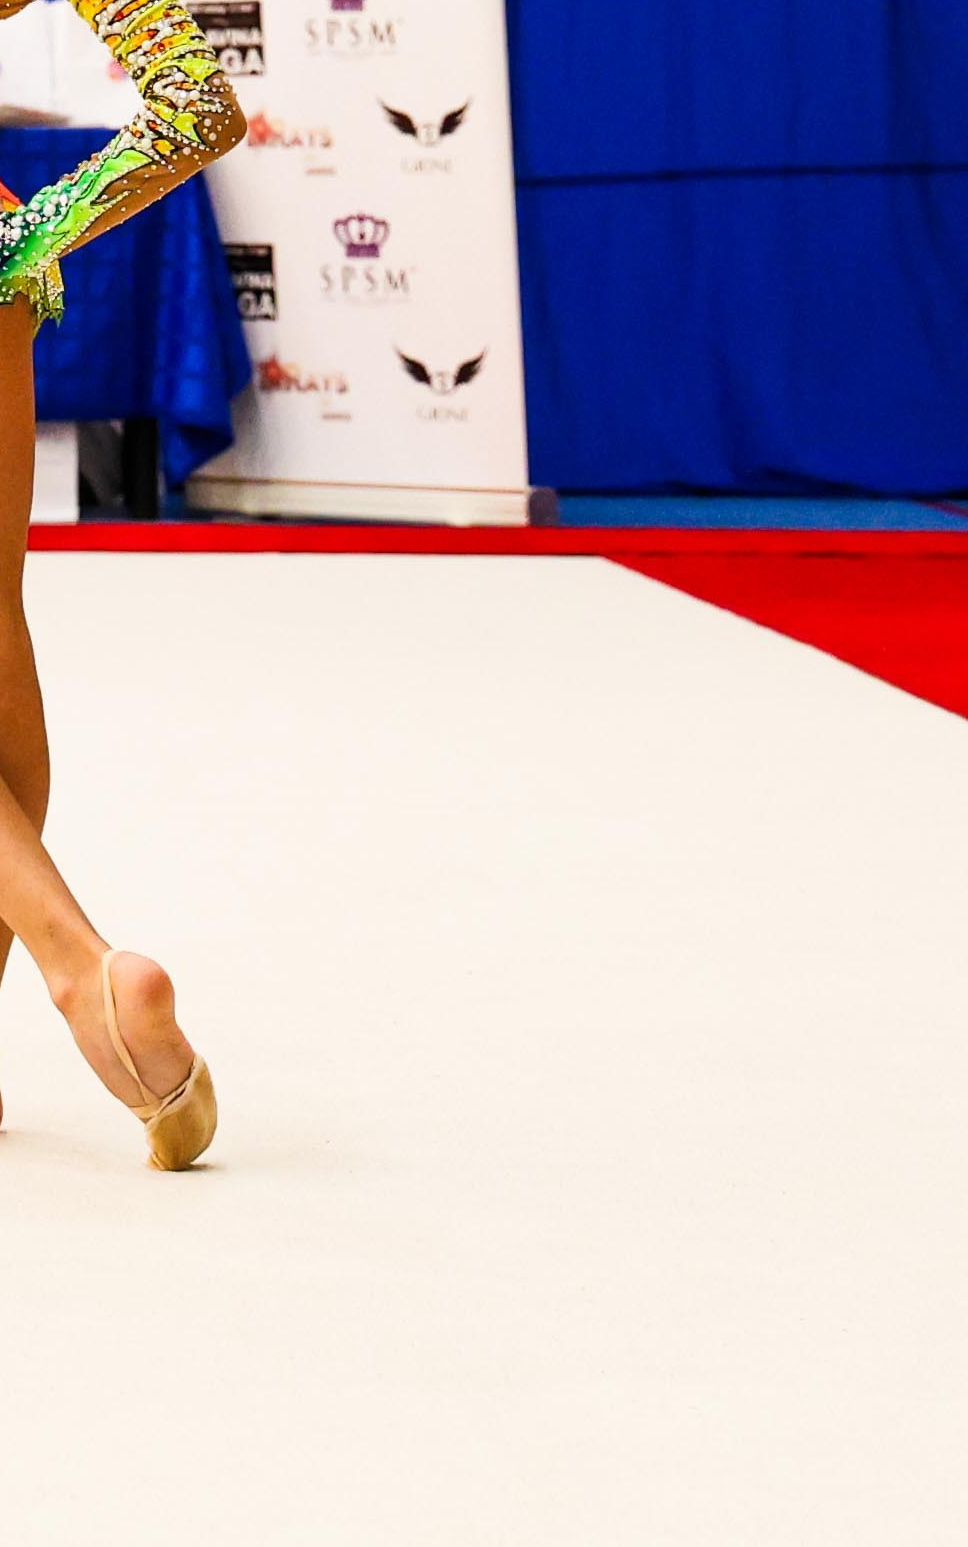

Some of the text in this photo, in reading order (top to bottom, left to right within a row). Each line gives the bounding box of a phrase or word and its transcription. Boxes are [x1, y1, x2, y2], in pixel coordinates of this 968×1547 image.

[305, 19, 398, 47] SPSM
[218, 48, 265, 74] GA
[319, 263, 411, 293] SPSM
[237, 290, 276, 319] GA
